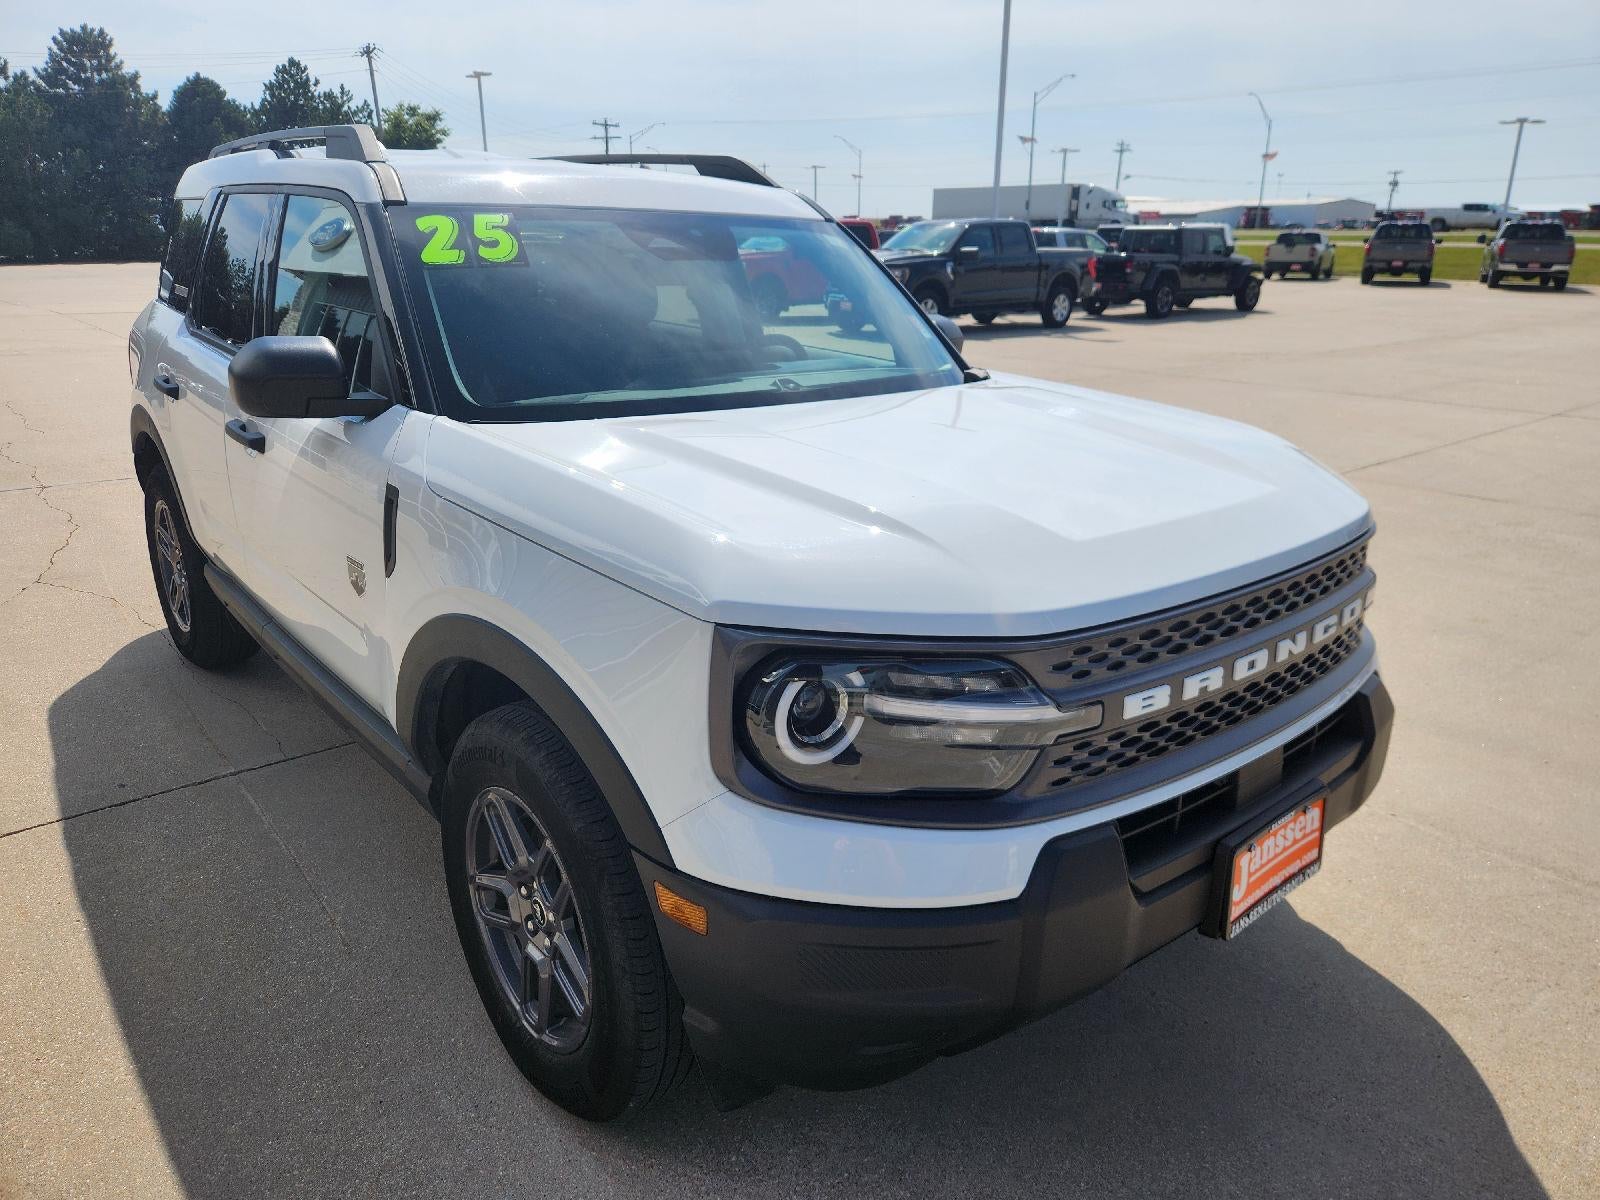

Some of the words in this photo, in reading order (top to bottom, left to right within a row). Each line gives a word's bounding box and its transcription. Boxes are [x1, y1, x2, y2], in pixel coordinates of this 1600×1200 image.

[415, 213, 519, 265] 25
[1122, 598, 1362, 720] BRONCO
[1233, 806, 1321, 901] Janssen
